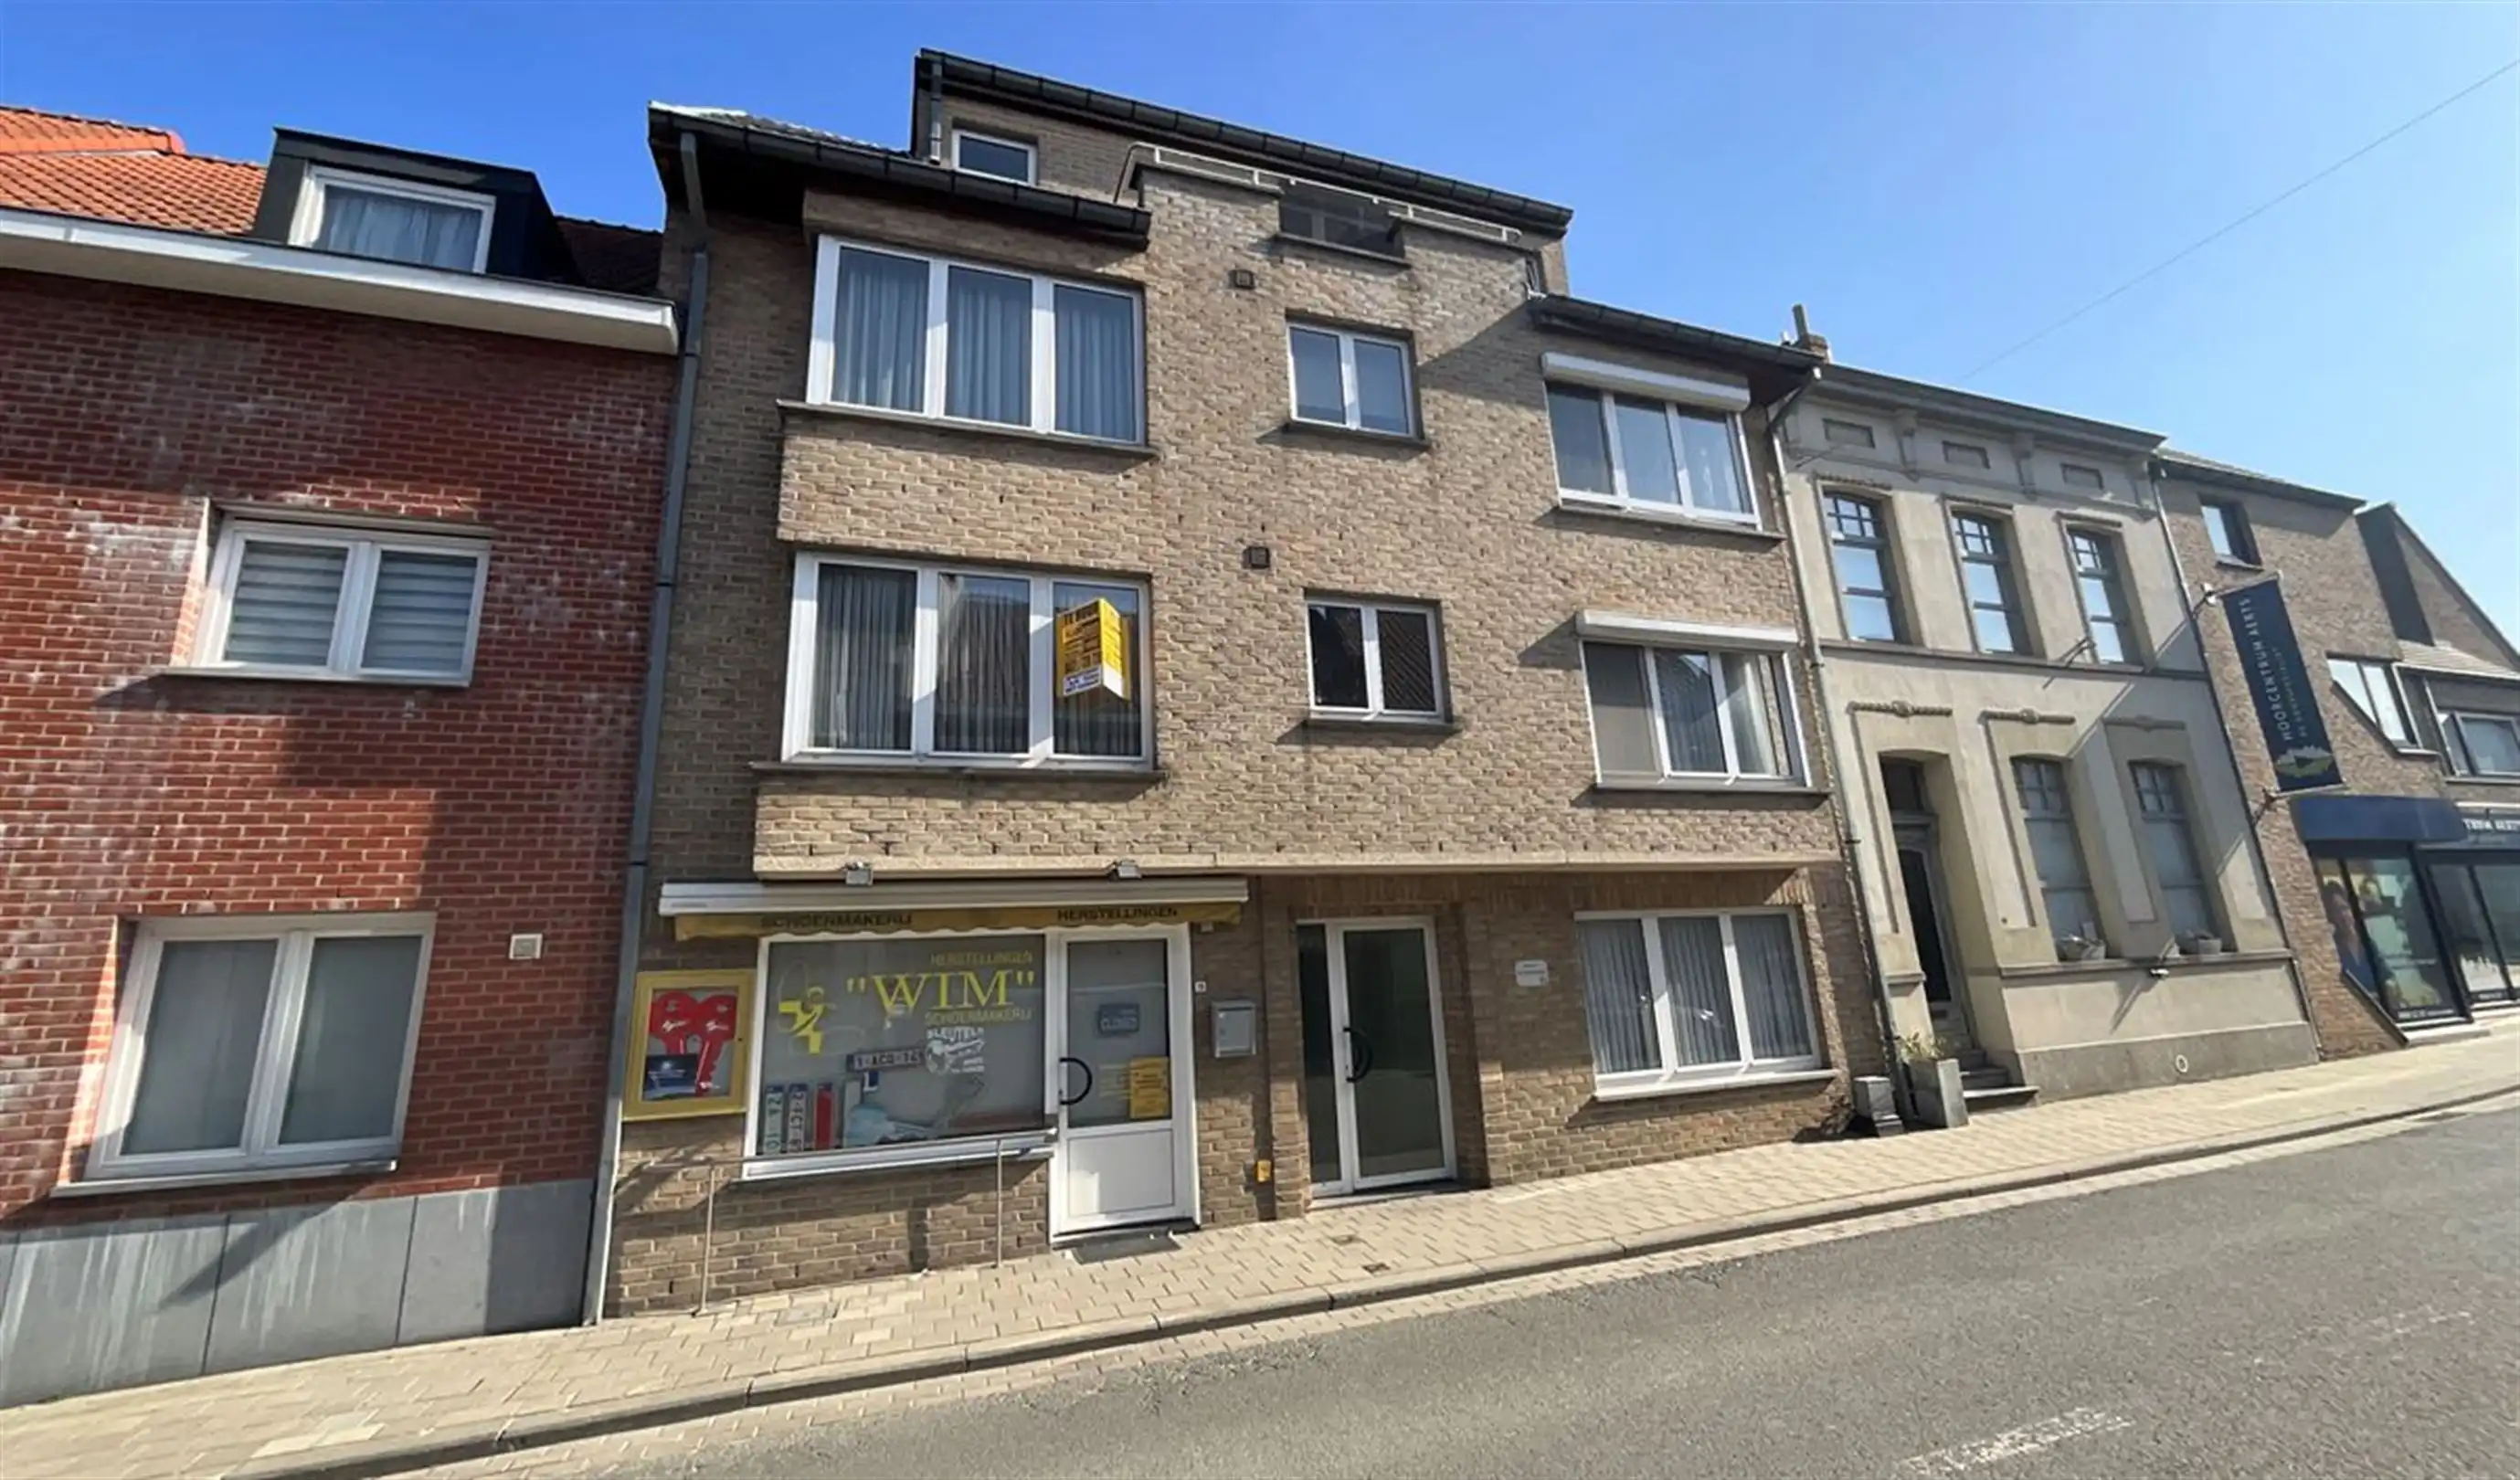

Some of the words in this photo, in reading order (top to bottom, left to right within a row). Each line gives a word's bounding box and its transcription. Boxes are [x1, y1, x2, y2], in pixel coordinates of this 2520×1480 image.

[2252, 640, 2294, 742] HOORCENTRUM
[761, 913, 912, 928] SCHOENMAKERIJ
[1056, 907, 1178, 922] HERSTELLINGEN
[930, 950, 1033, 966] HERSTELLINGEN
[846, 968, 1035, 1013] "WIM"
[925, 1007, 1032, 1025] SCHOENMAKERIJ
